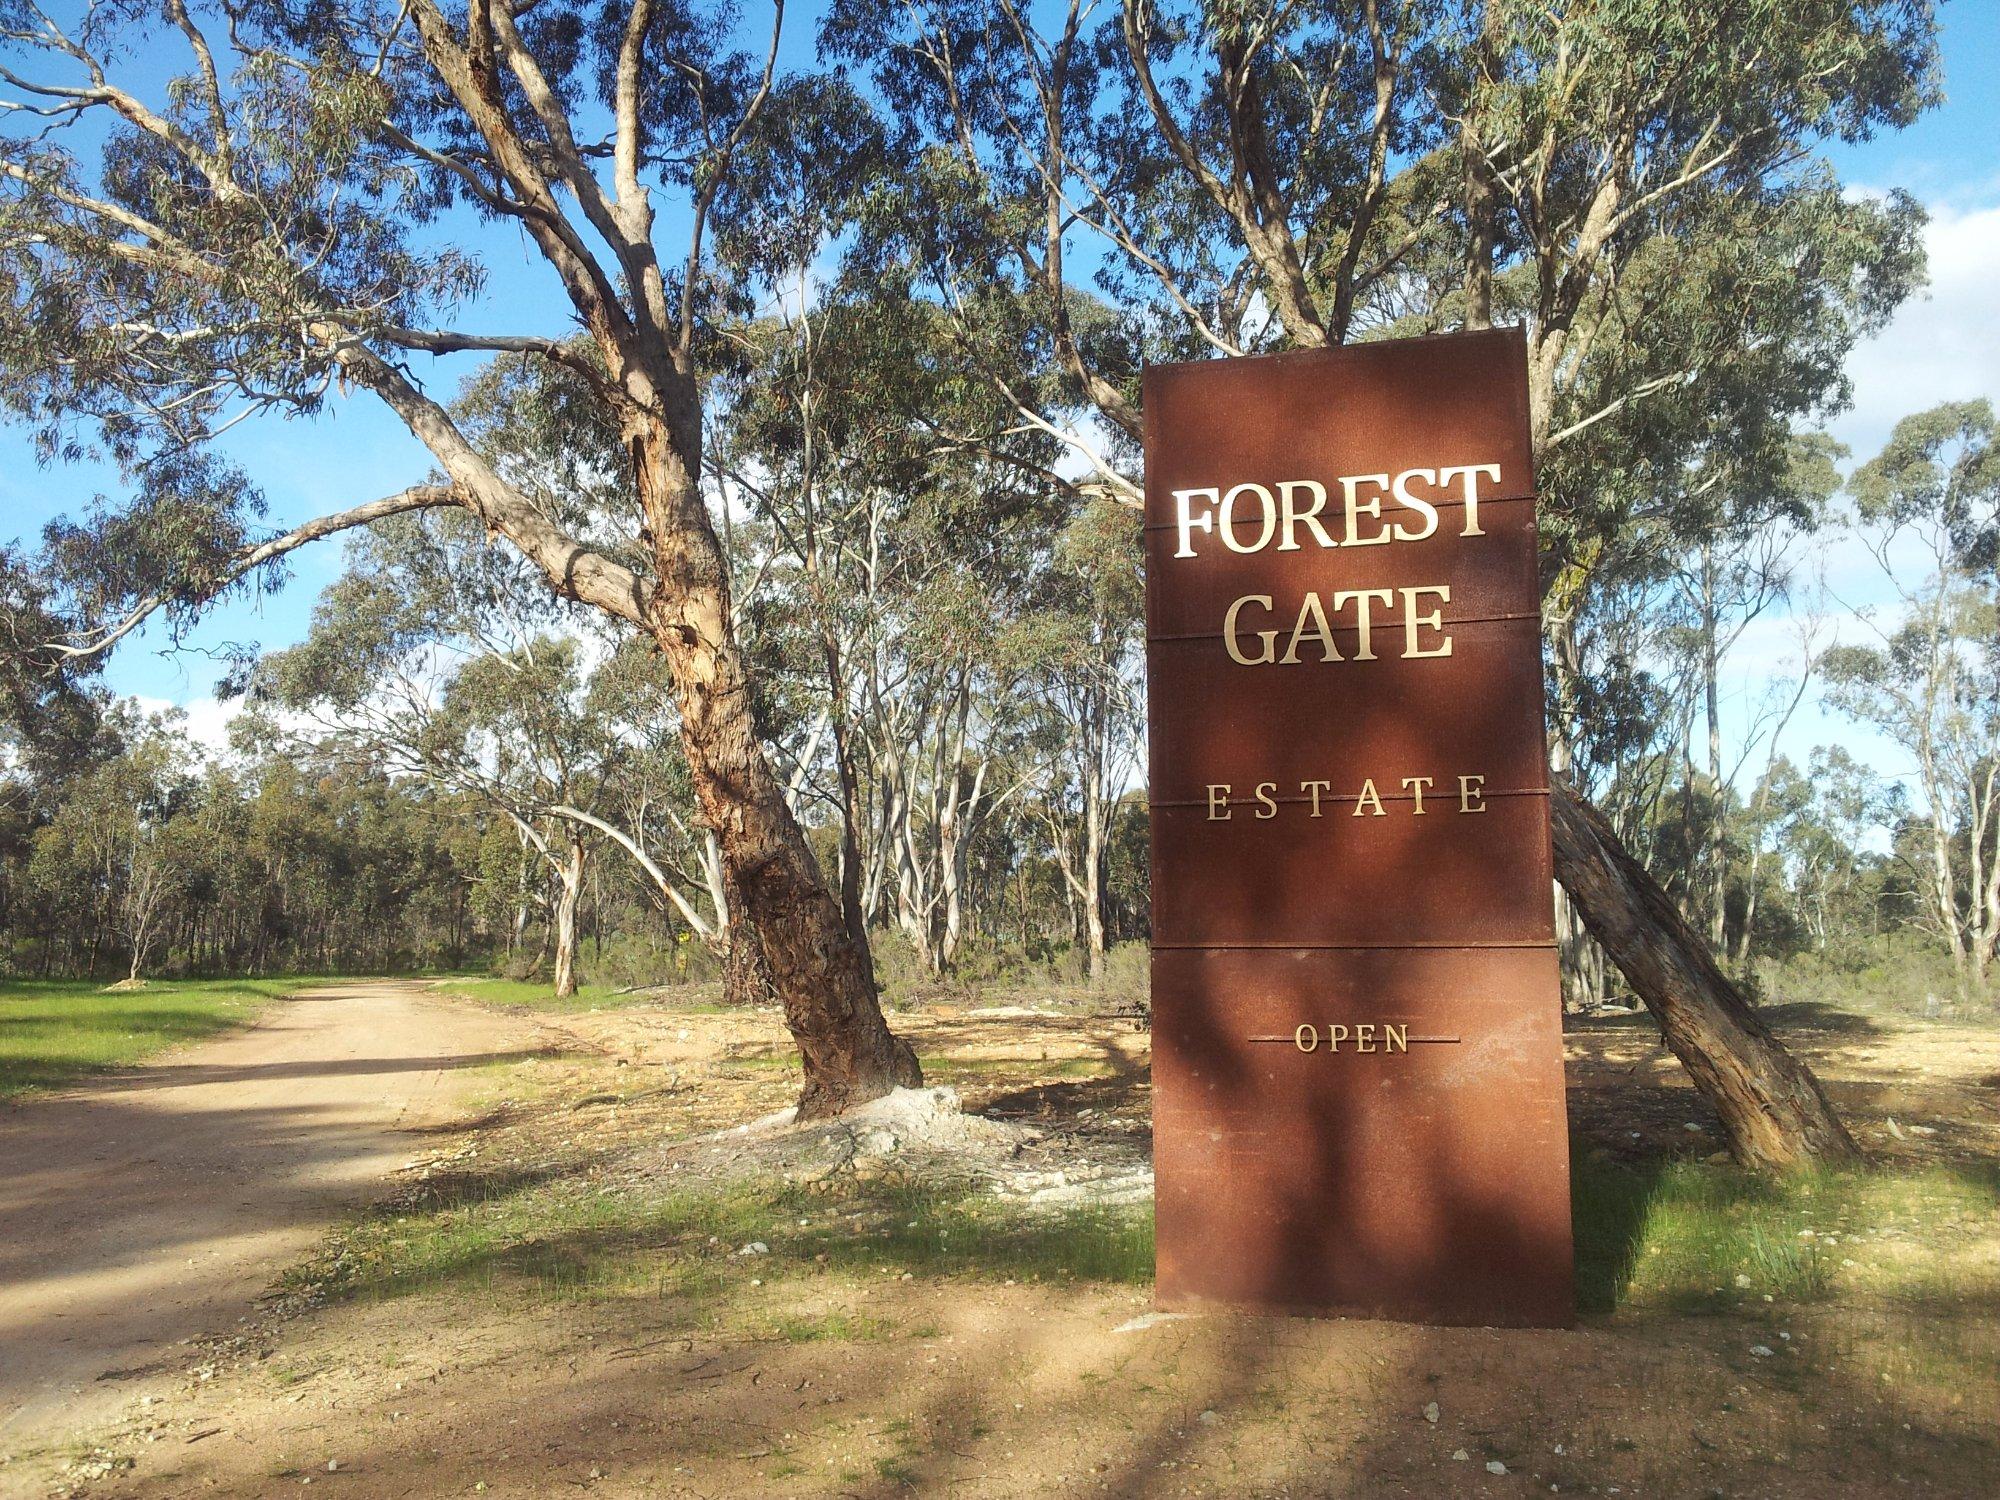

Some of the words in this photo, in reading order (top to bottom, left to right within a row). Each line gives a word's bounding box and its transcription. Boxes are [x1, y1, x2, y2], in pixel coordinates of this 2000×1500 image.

[1172, 463, 1501, 559] FOREST
[1223, 585, 1453, 666] GATE
[1206, 774, 1487, 821] ESTATE
[1295, 1023, 1409, 1053] OPEN
